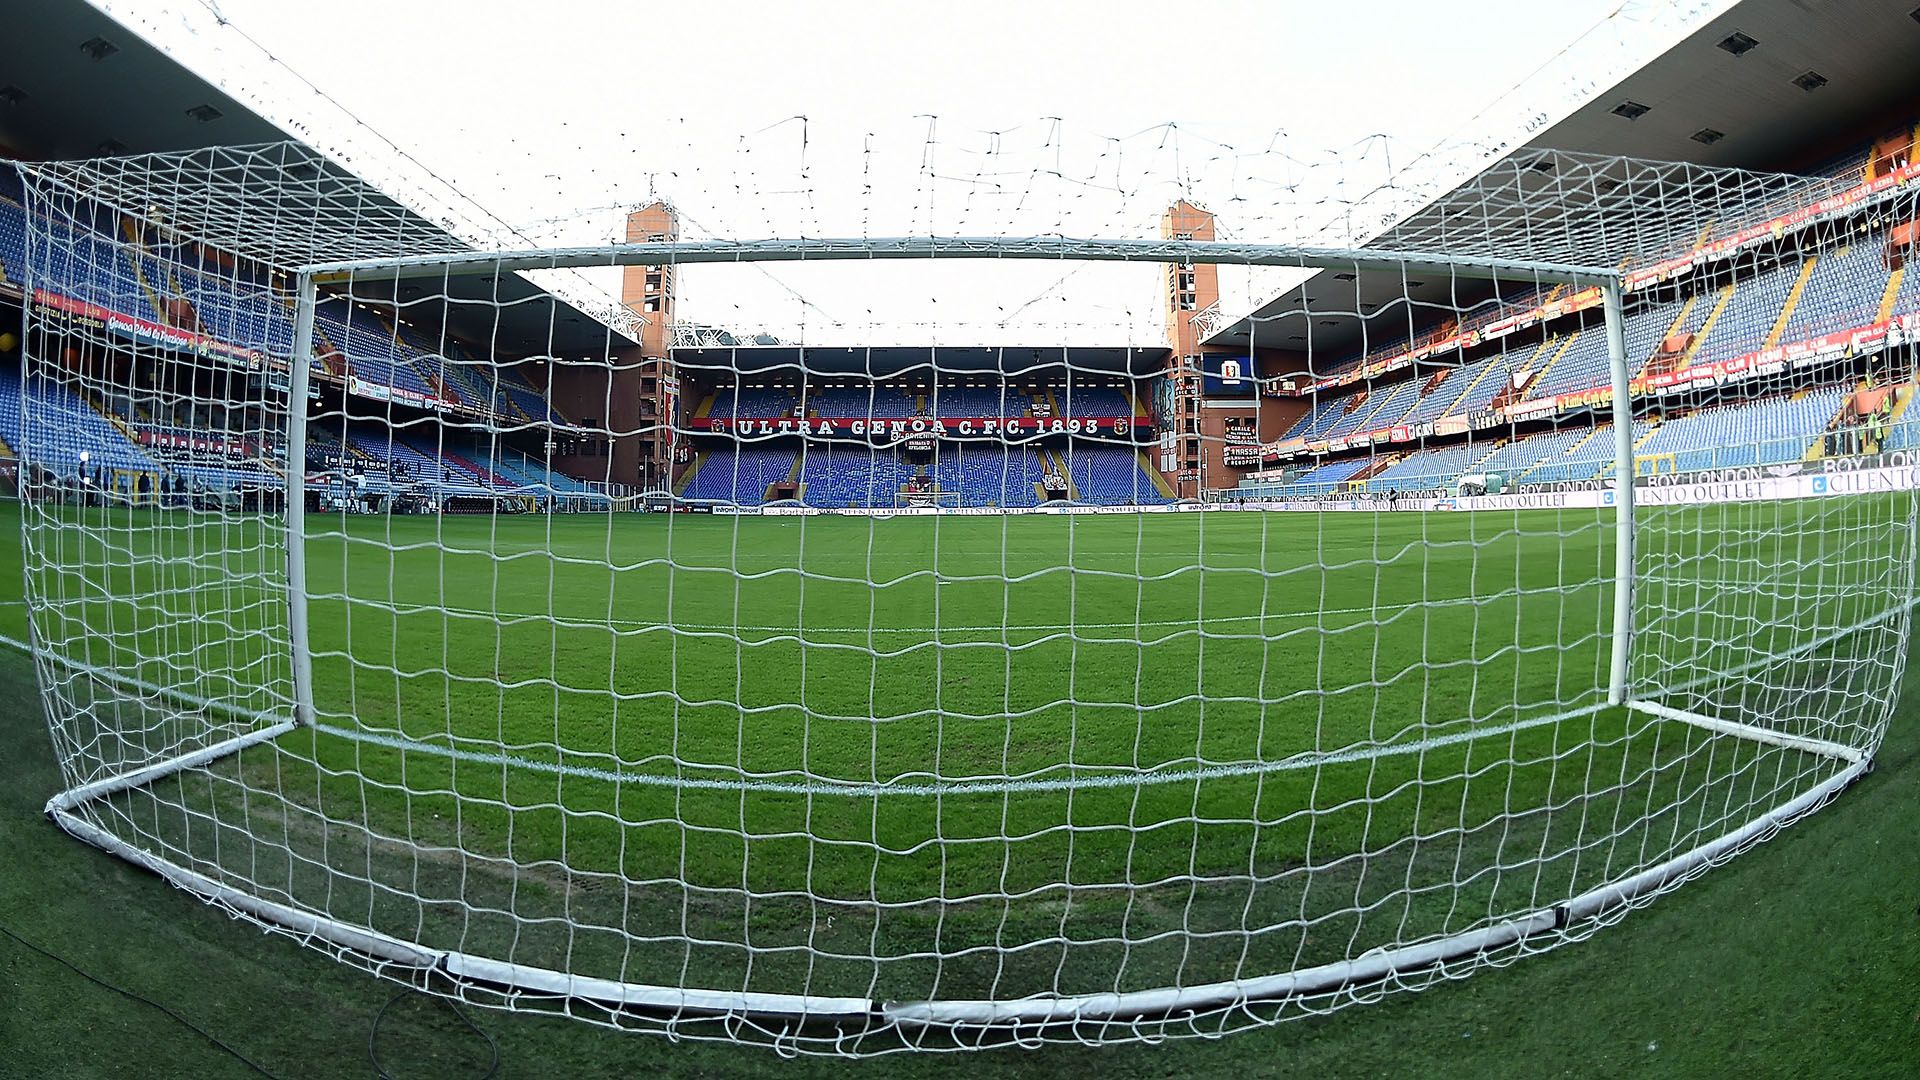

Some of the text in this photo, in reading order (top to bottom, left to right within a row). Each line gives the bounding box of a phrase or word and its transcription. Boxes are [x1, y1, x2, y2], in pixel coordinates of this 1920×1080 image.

[851, 420, 947, 435] GENOA
[1036, 418, 1098, 434] 1893
[1648, 467, 1763, 488] BOY LONDON
[1550, 480, 1601, 493] LONDON
[1694, 481, 1767, 500] OUTLET
[1517, 493, 1568, 507] OUTLET
